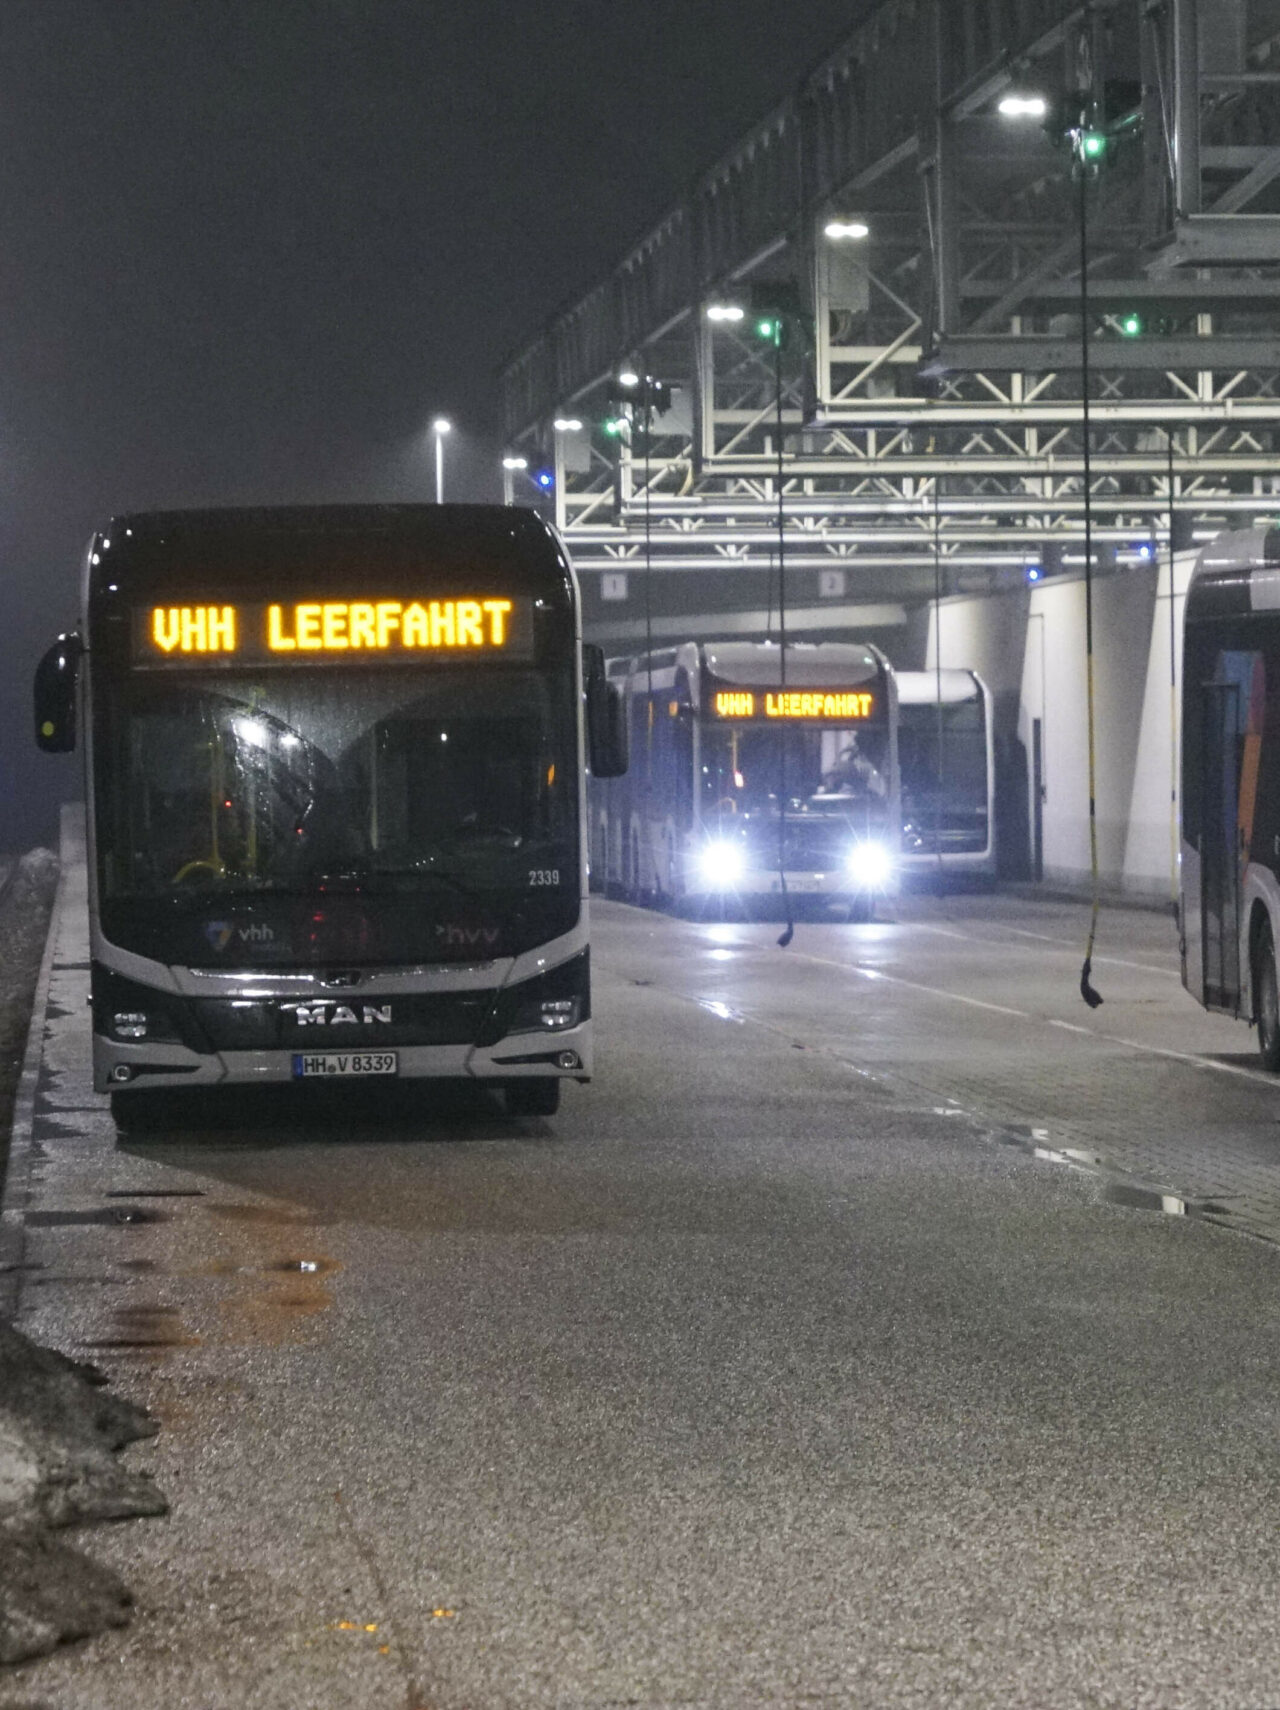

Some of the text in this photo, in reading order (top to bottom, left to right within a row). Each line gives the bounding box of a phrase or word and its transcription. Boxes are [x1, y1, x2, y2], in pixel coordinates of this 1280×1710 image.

[152, 601, 512, 651] VHH LEERFAHRT
[716, 693, 873, 717] VHH LEERFAHRT
[528, 869, 560, 886] 2339
[238, 922, 275, 942] vhh
[297, 1005, 393, 1026] MAN
[304, 1054, 394, 1073] HH V 8339
